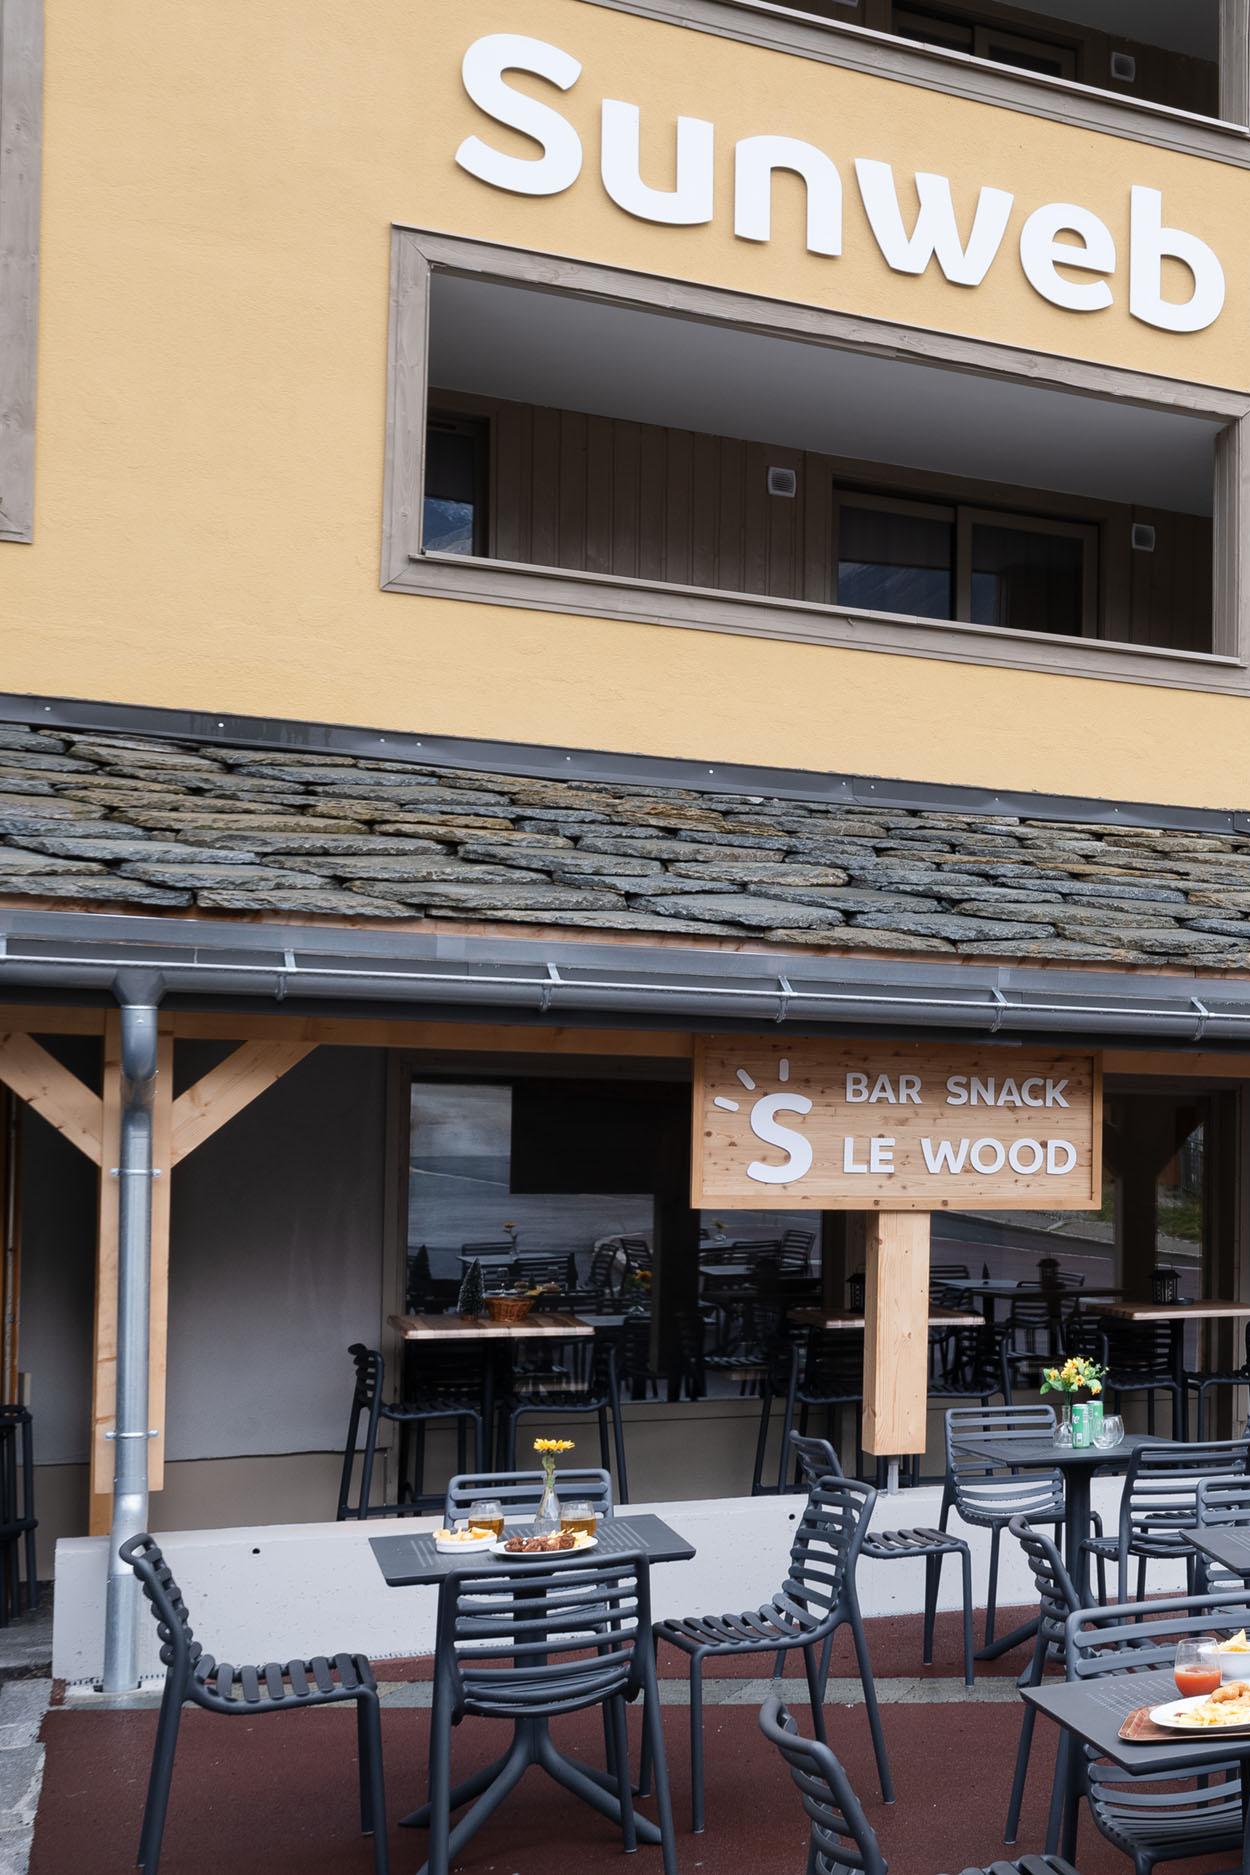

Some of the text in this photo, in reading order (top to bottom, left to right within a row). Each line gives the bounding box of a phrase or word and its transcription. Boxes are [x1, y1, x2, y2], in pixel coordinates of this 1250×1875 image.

[454, 32, 1227, 334] Sunweb
[845, 1072, 1070, 1109] BAR SNACK
[746, 1092, 814, 1184] S
[843, 1136, 1077, 1176] LE WOOD
